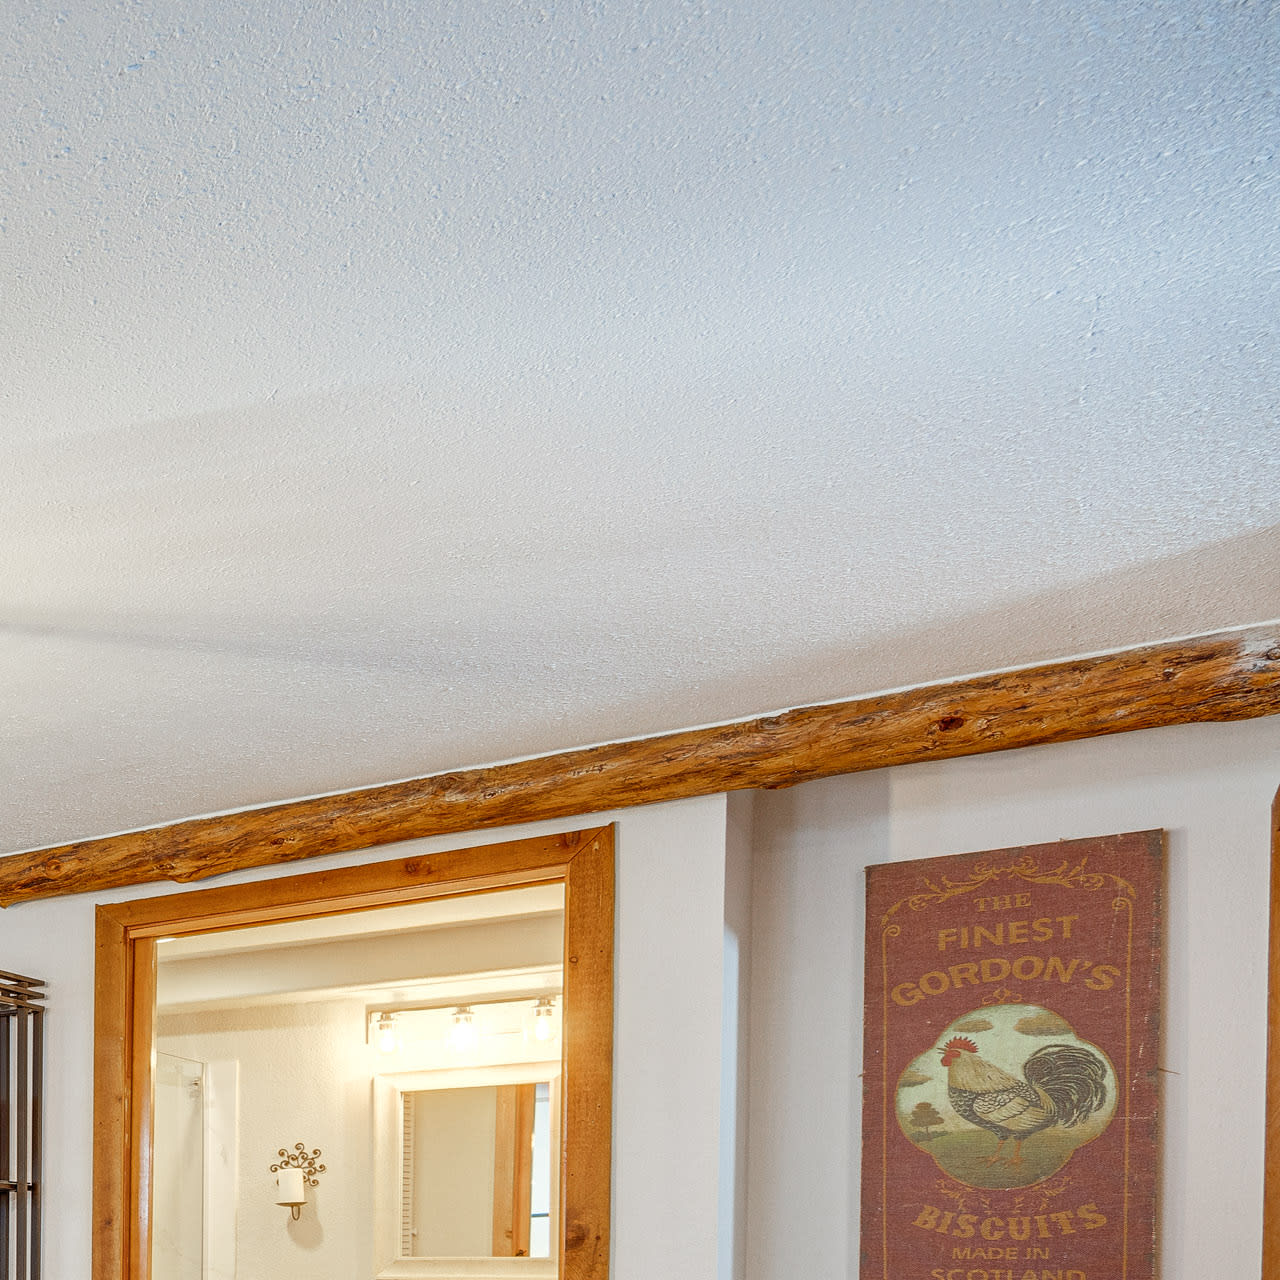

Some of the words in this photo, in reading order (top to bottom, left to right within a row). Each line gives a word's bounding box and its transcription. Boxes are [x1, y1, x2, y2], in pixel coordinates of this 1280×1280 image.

[973, 892, 1032, 912] THE
[937, 915, 1080, 951] FINEST
[891, 955, 1121, 1006] GORDON'S
[911, 1202, 1108, 1241] BISCUITS
[951, 1247, 1018, 1260] MADE
[1024, 1247, 1050, 1260] IN
